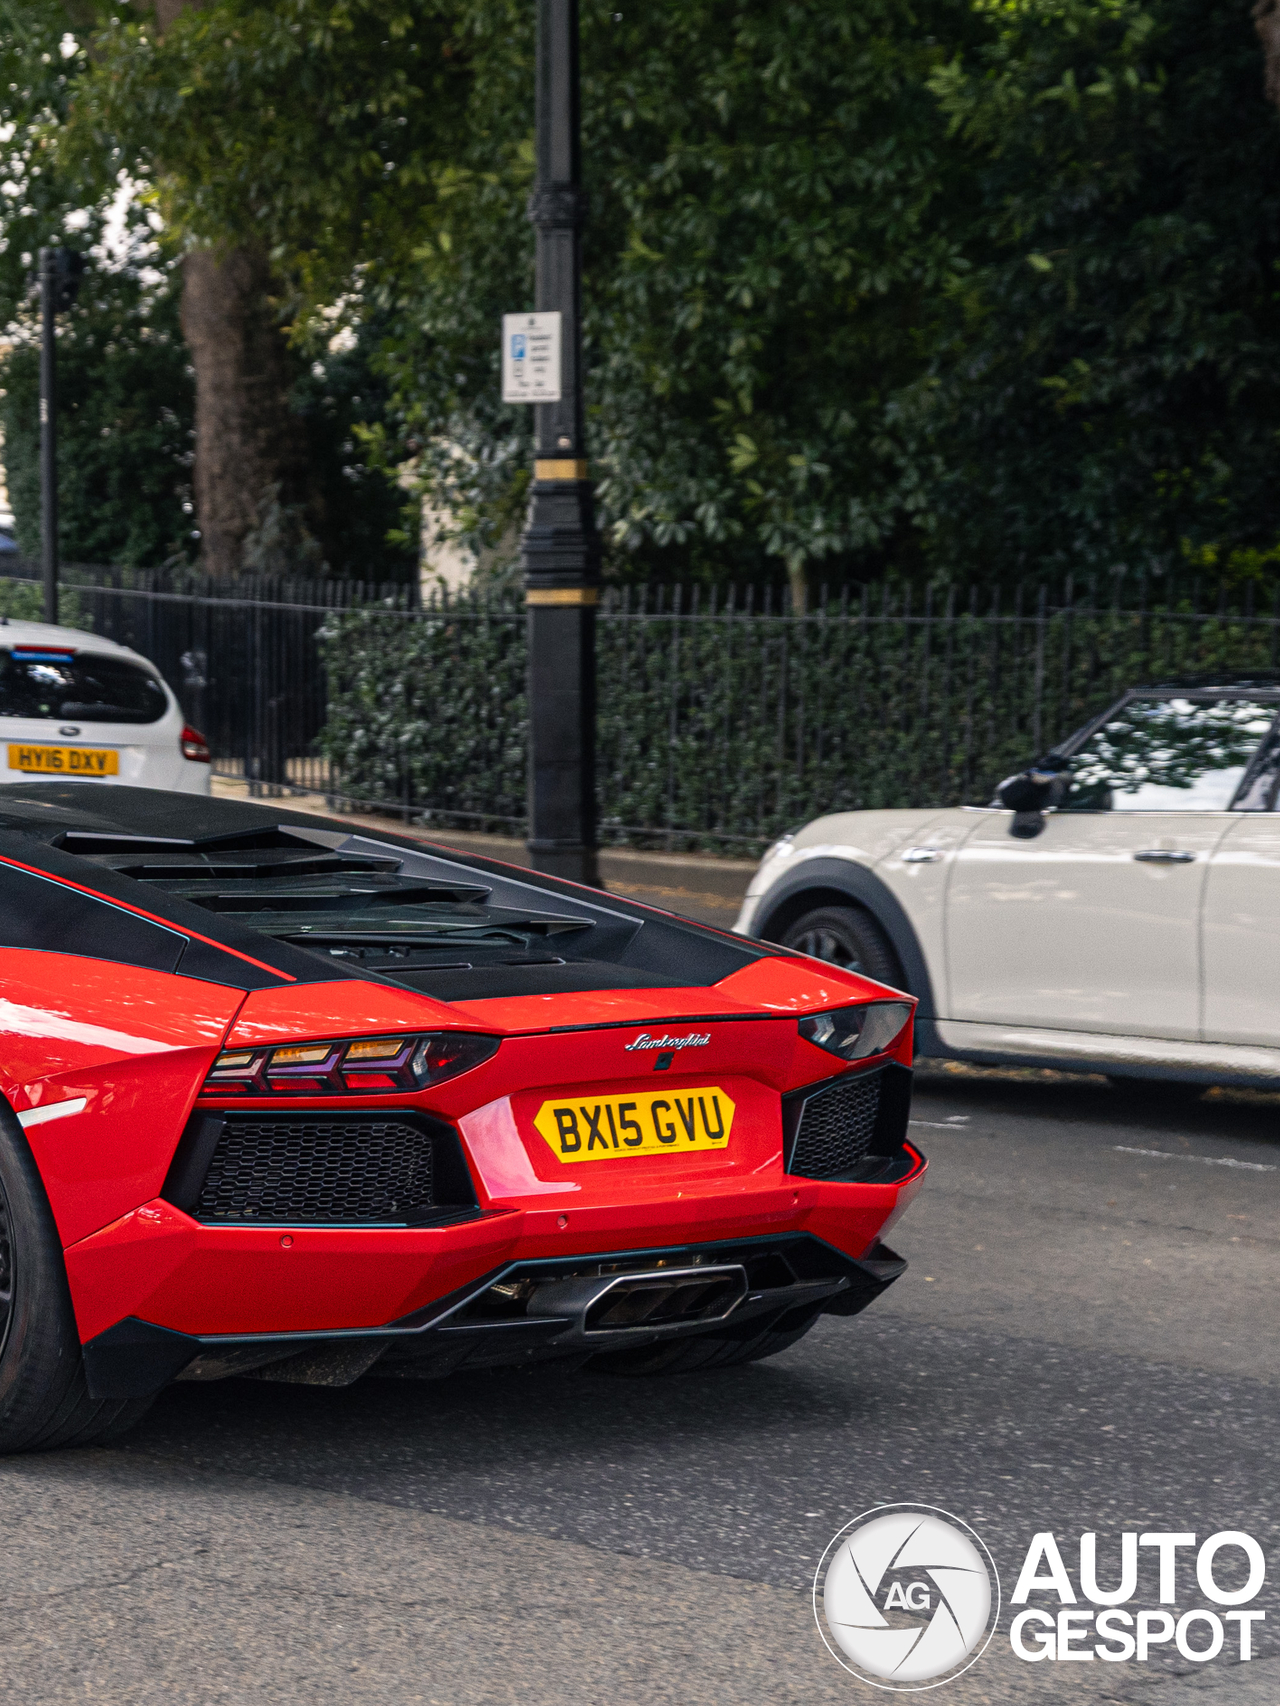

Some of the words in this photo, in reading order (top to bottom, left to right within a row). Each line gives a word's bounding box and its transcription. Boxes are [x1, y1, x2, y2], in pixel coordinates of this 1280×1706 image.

[19, 747, 62, 769] HY16
[68, 750, 107, 770] DXV
[624, 1033, 711, 1051] Lamborghini
[553, 1102, 643, 1153] BX15
[650, 1095, 725, 1144] GVU
